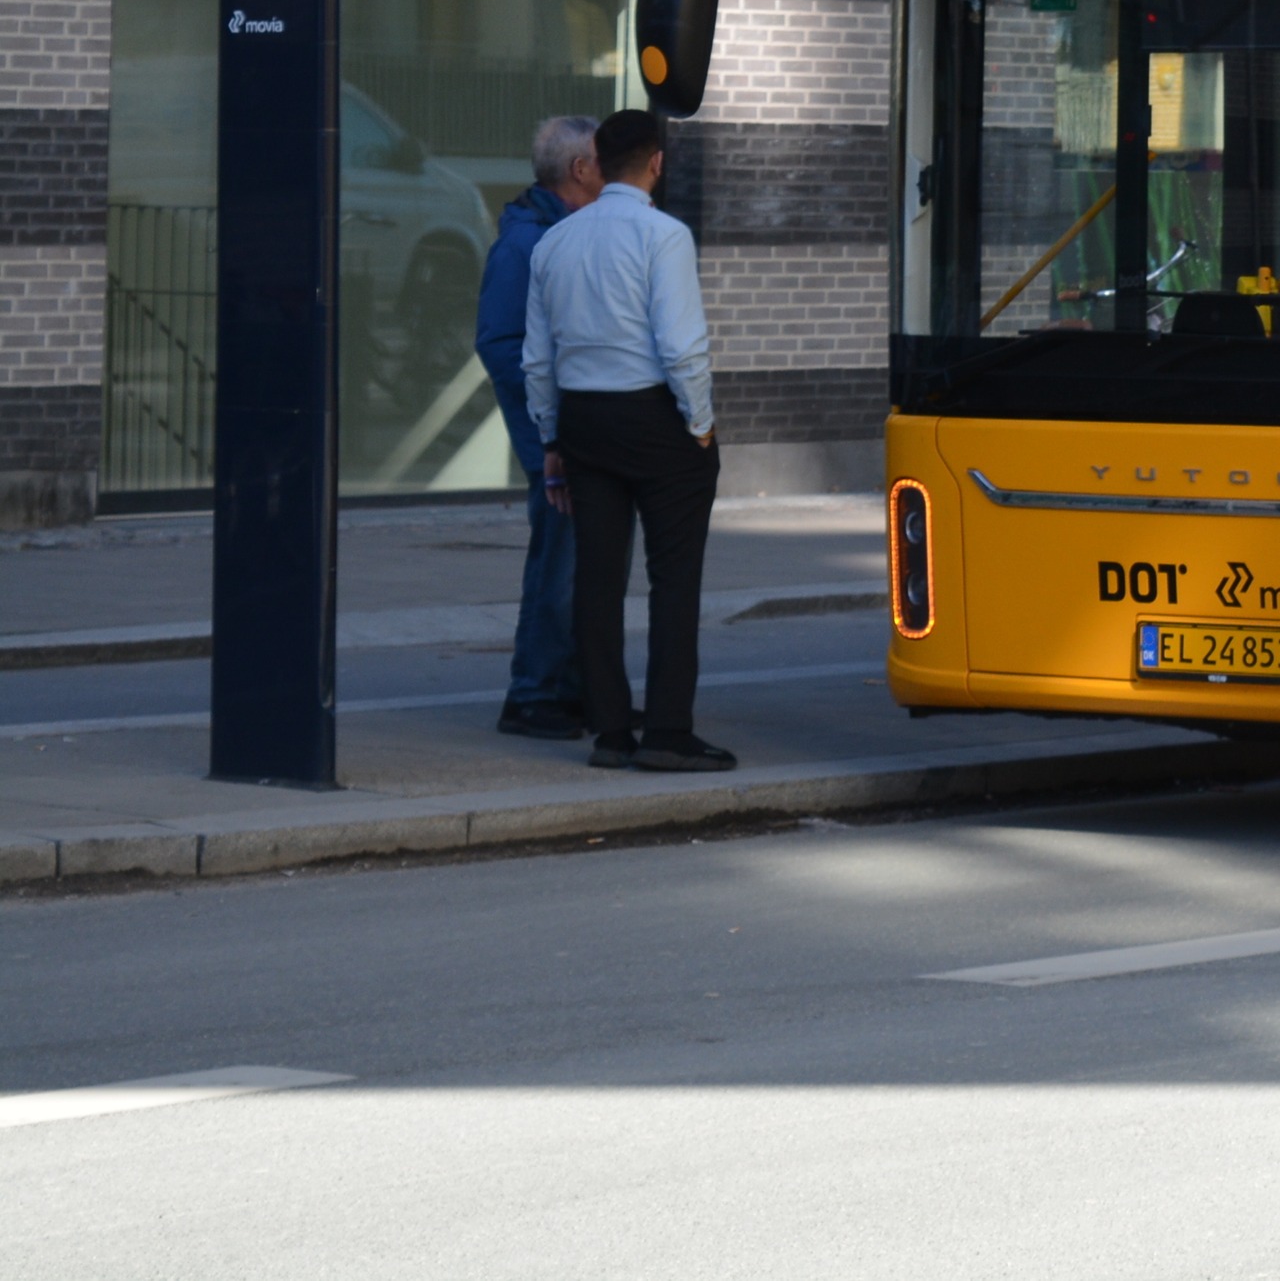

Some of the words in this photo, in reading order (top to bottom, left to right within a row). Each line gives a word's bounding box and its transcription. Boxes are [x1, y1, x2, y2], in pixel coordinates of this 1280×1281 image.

[245, 16, 283, 33] movia
[1098, 560, 1188, 605] DOT
[1143, 649, 1155, 661] DK
[1160, 633, 1193, 664] EL
